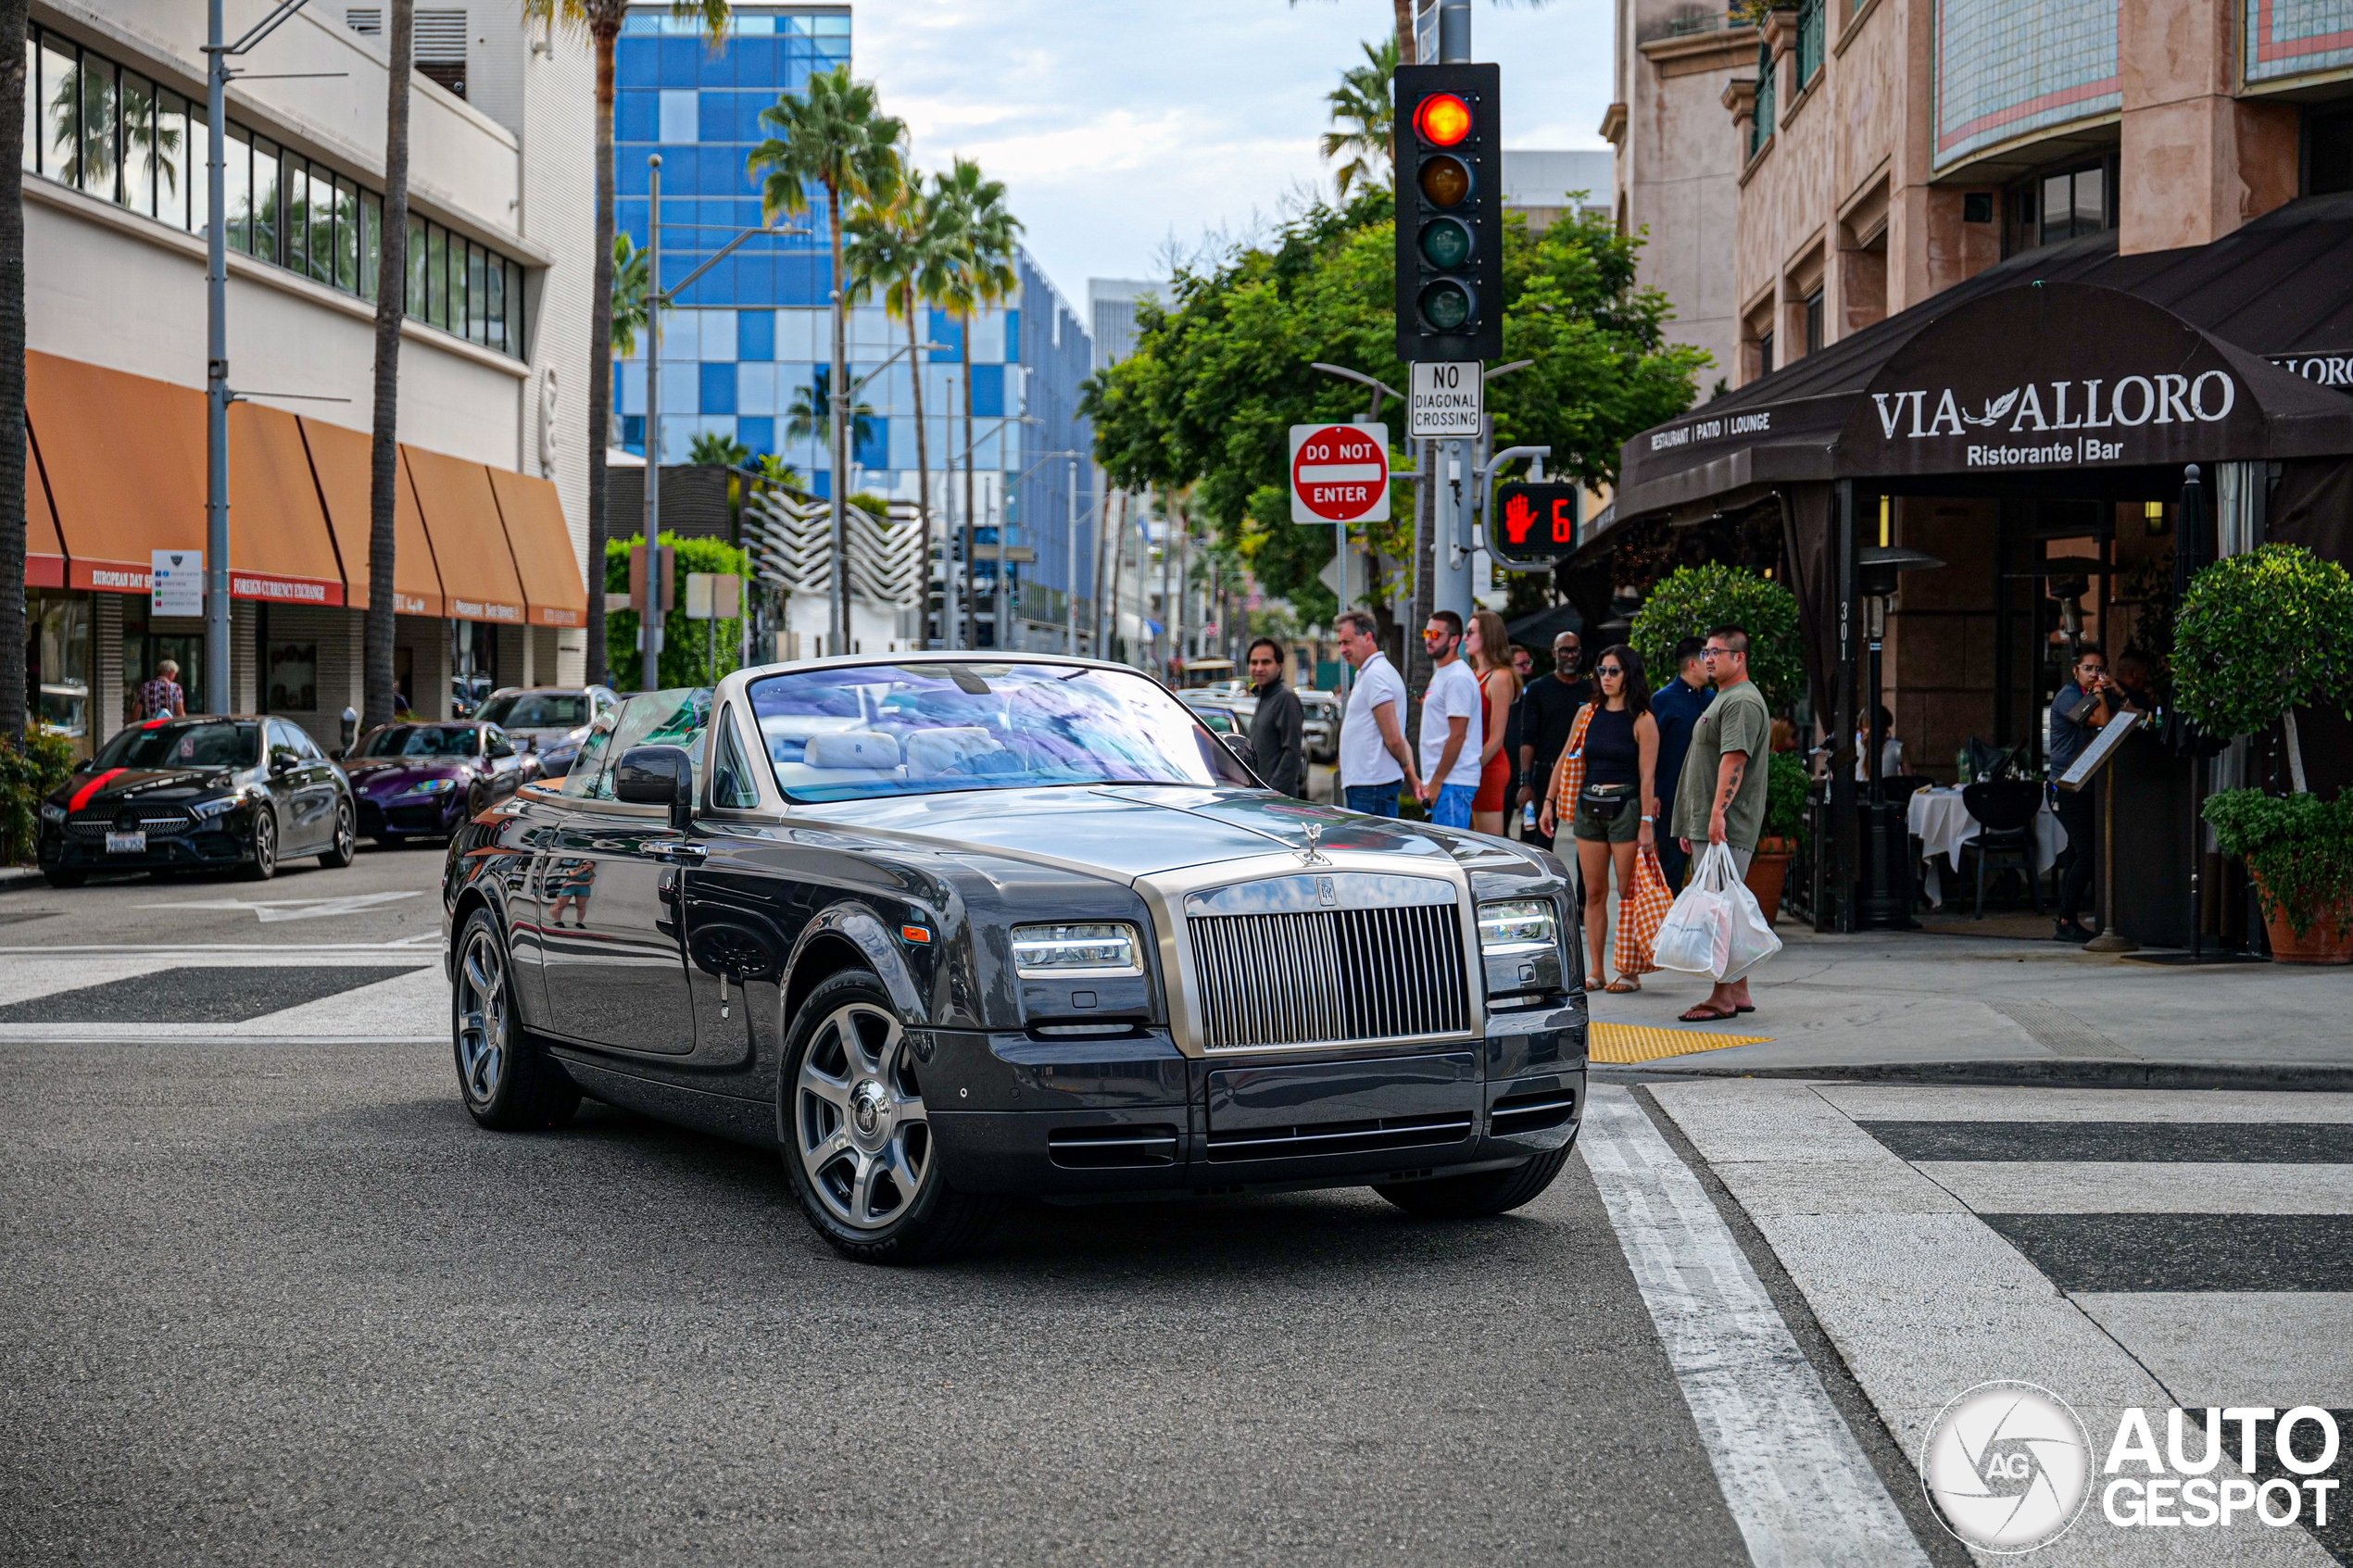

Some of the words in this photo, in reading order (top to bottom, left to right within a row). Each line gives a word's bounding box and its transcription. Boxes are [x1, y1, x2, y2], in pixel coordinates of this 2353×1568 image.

[1433, 366, 1459, 389] NO
[1416, 394, 1477, 408] DIAGONAL
[1872, 388, 1966, 439] VIA
[2008, 370, 2235, 433] ALLORO
[1415, 411, 1477, 426] CROSSING
[1651, 427, 1690, 451] RESTAURANT
[1696, 420, 1721, 441] PATIO
[1730, 412, 1770, 434] LOUNGE
[1306, 445, 1330, 460] DO
[1340, 443, 1373, 459] NOT
[1967, 442, 2073, 467] Ristorante
[2086, 438, 2123, 461] Bar
[1314, 486, 1367, 503] ENTER
[1552, 498, 1571, 544] 6
[93, 570, 129, 587] EUROPEAN
[130, 572, 144, 588] DAY
[233, 578, 261, 595] FOREIGN
[261, 580, 294, 598] CURRENCY
[295, 583, 325, 601] EXCHANGE
[808, 975, 869, 1009] EAGLE
